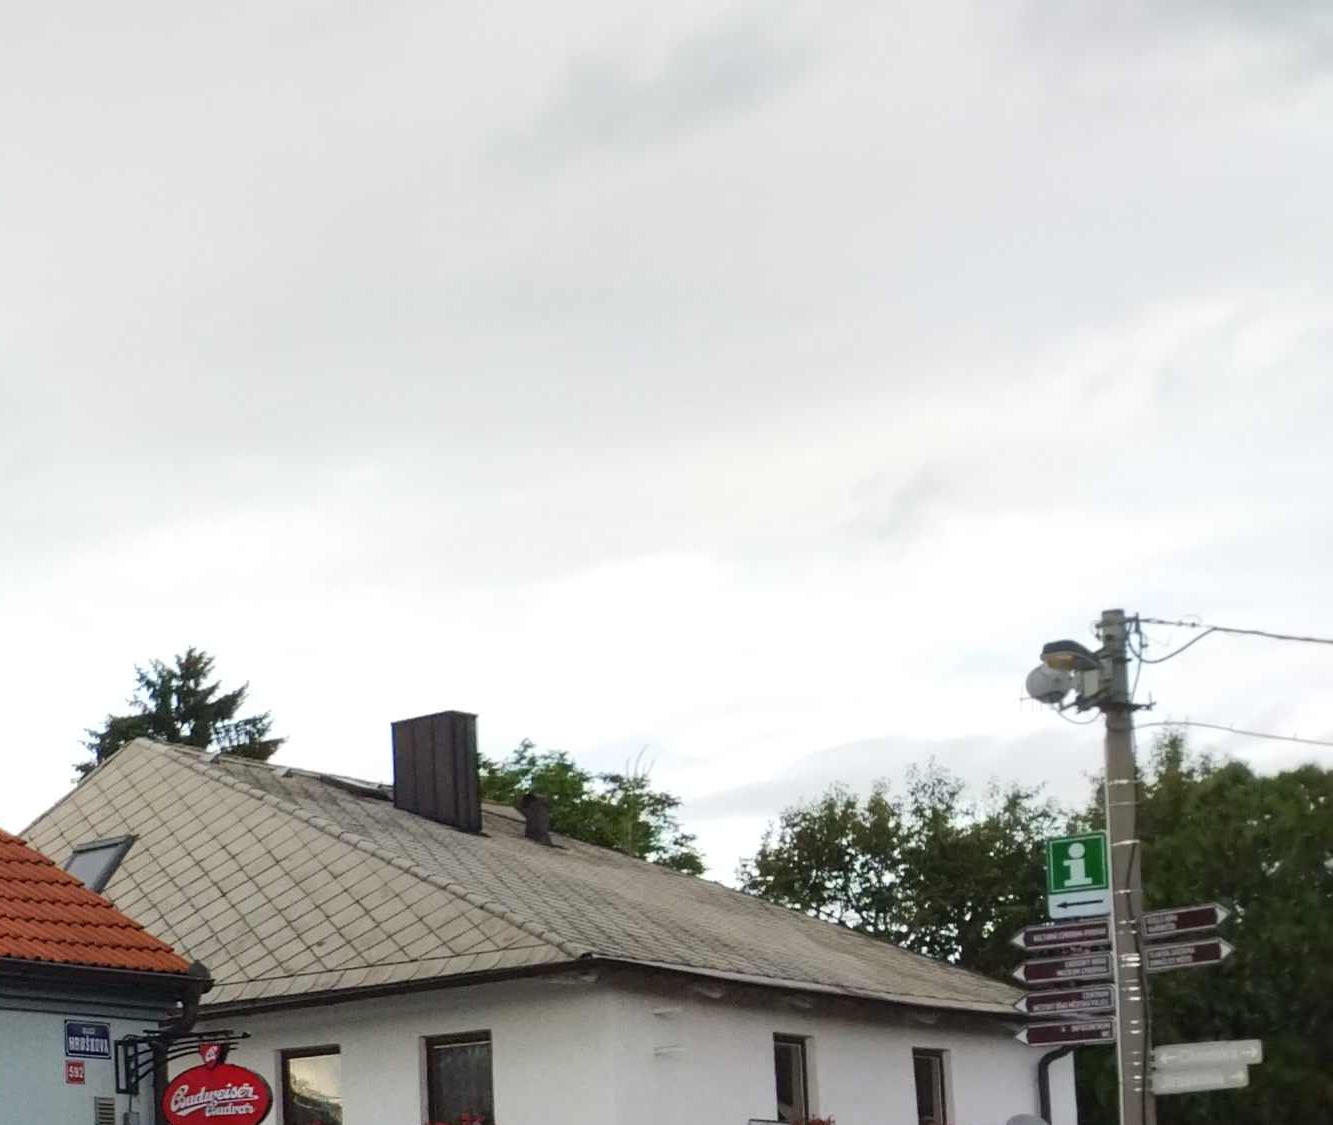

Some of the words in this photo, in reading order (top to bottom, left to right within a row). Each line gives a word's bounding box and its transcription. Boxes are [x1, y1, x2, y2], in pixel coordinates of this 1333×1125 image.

[69, 1035, 109, 1054] HRUŠKOVA
[69, 1066, 84, 1079] 592
[170, 1082, 259, 1114] Budweiser
[205, 1099, 256, 1118] Budvar
